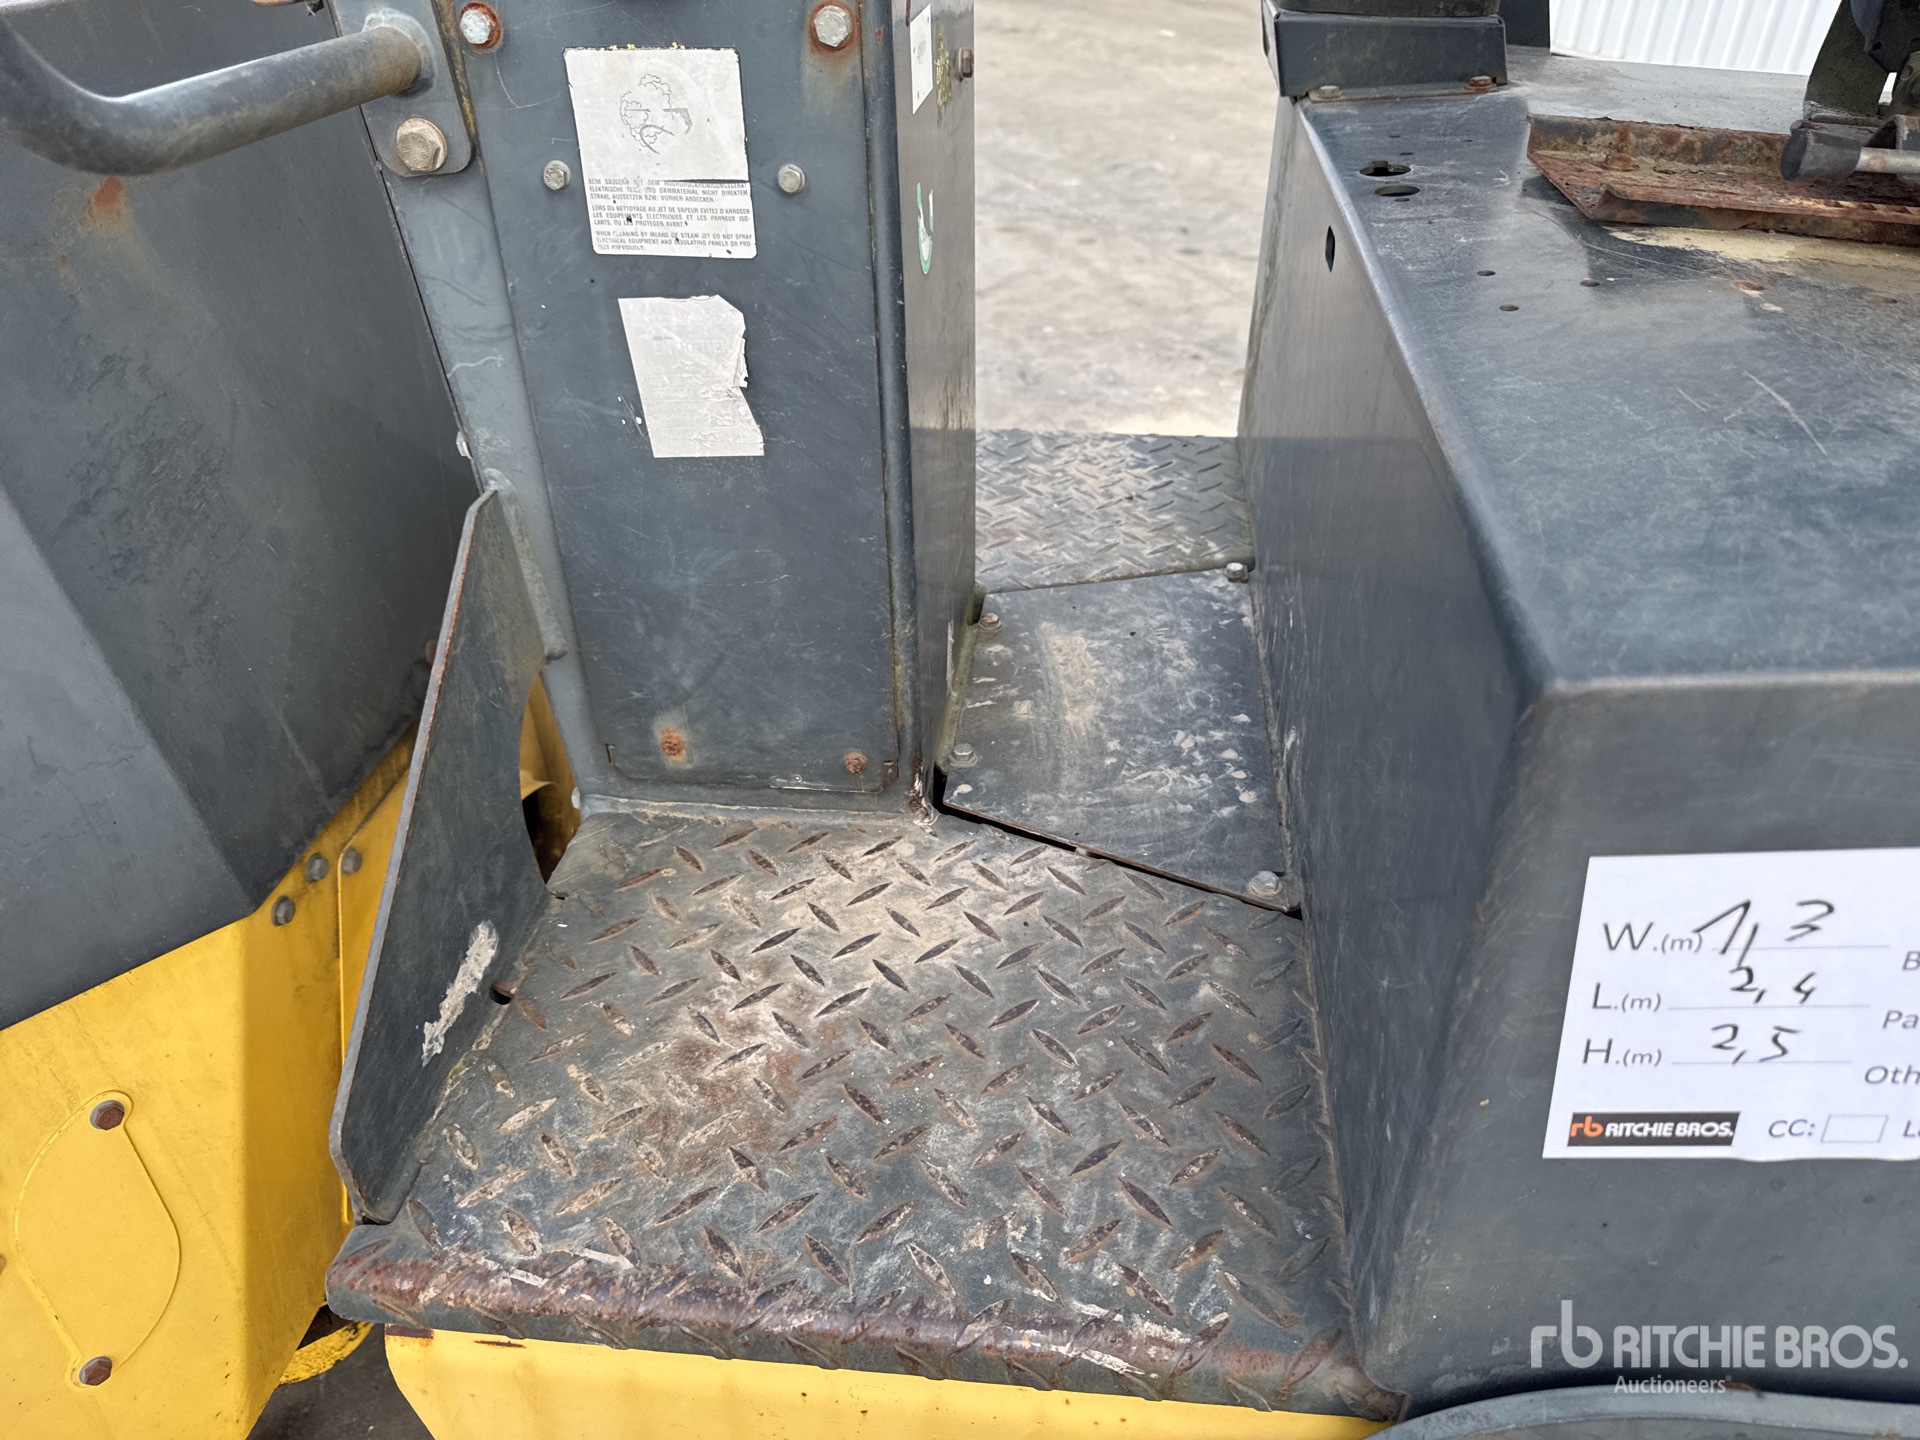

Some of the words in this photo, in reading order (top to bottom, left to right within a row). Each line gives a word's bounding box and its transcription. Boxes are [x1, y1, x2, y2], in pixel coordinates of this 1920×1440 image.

[612, 193, 643, 201] AUSSETZEN
[592, 204, 606, 212] LORS
[646, 213, 683, 221] ELECTRIQUES
[1605, 1122, 1674, 1137] RITCHIE
[1675, 1122, 1733, 1137] BROS.
[1768, 1120, 1815, 1138] CC:
